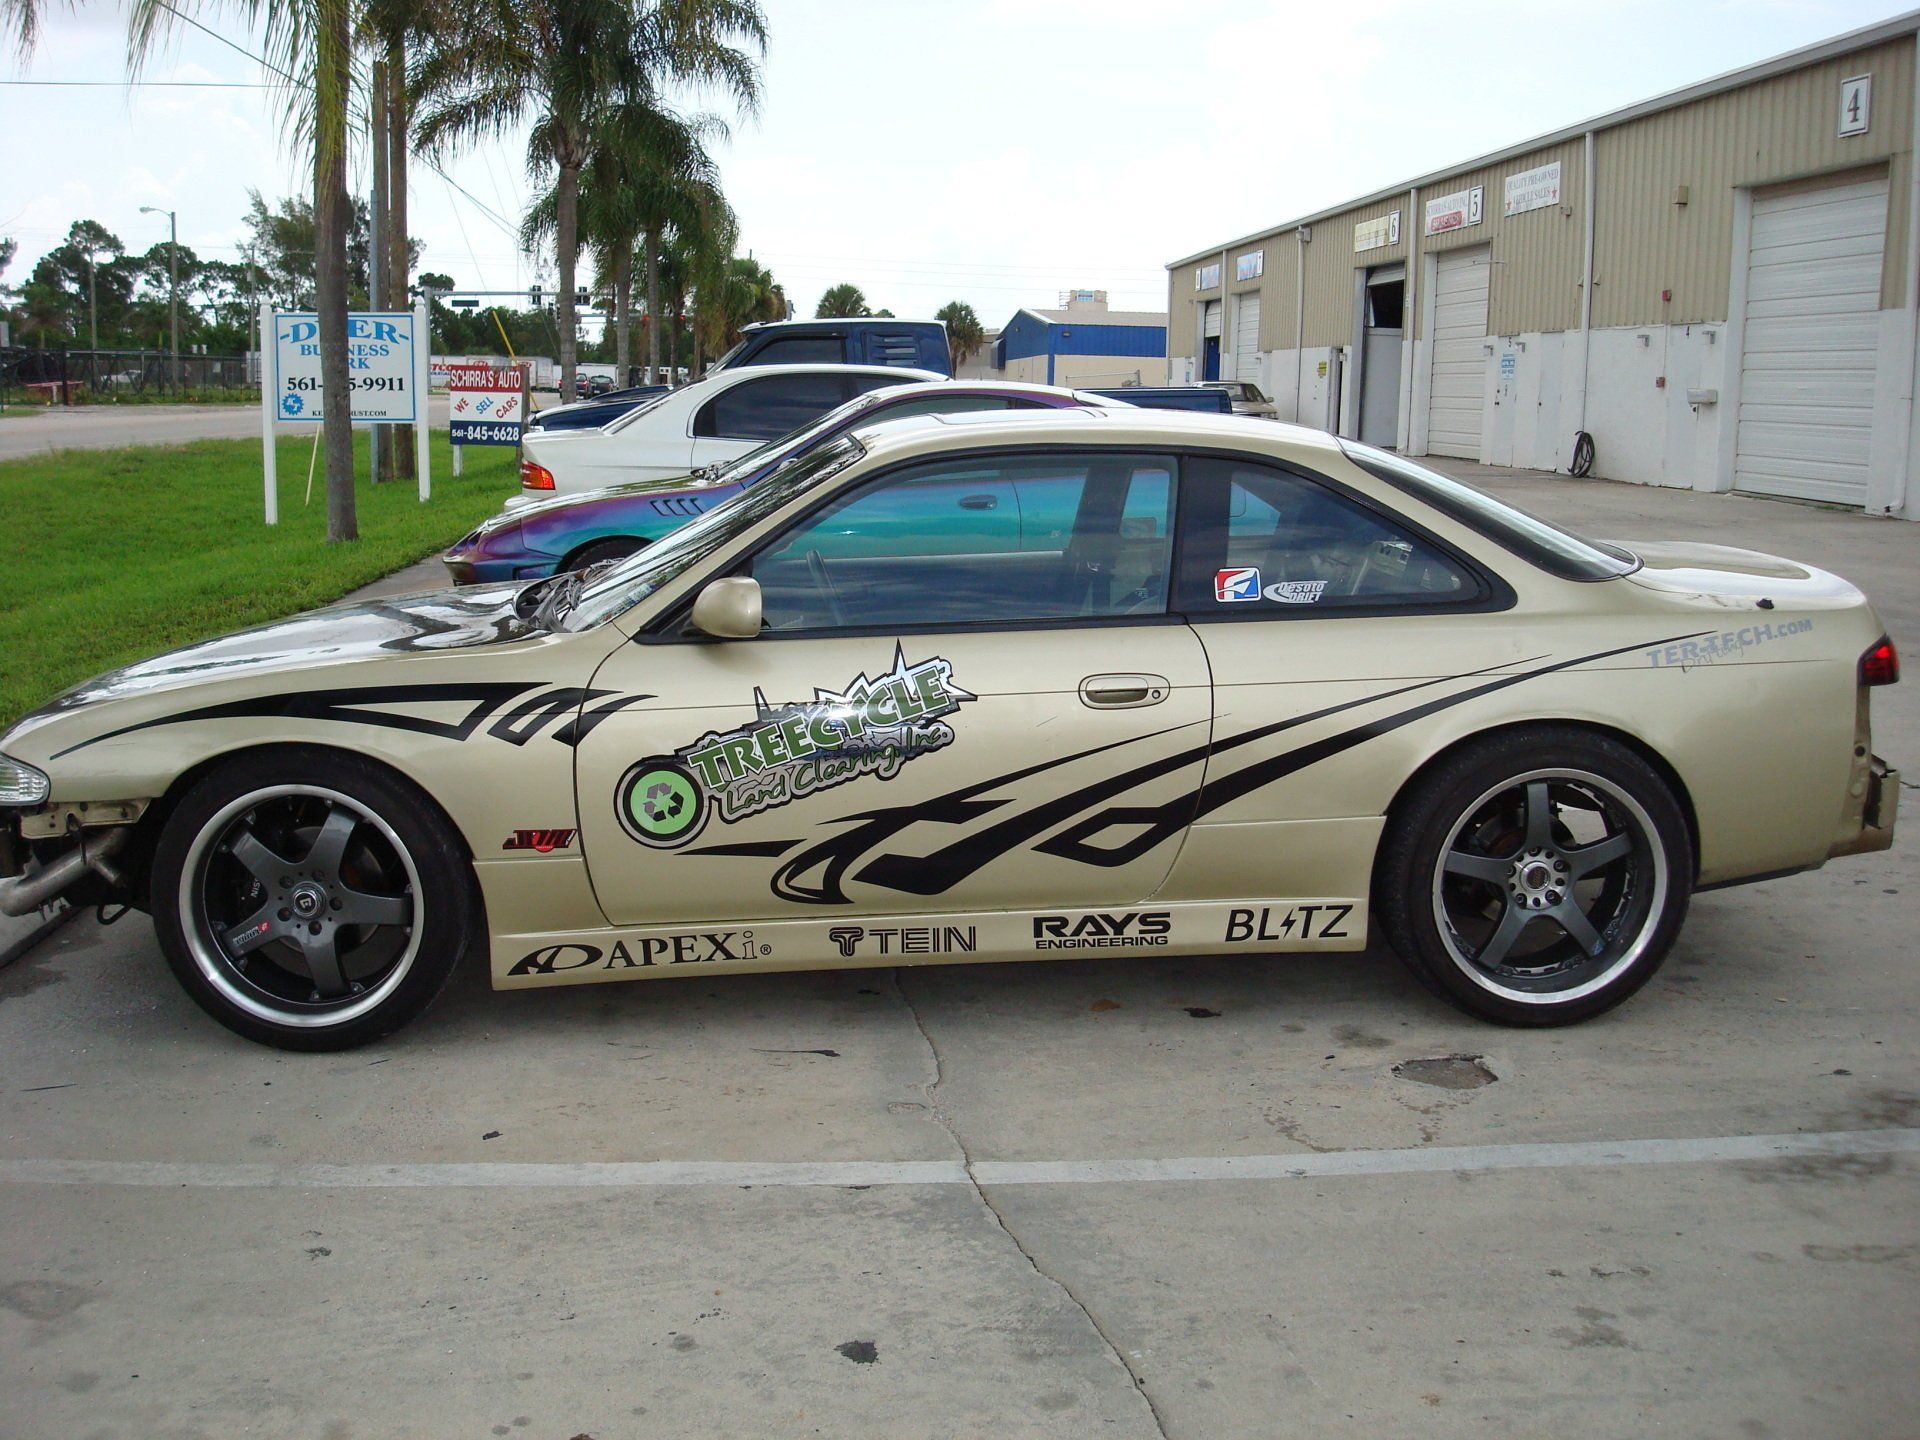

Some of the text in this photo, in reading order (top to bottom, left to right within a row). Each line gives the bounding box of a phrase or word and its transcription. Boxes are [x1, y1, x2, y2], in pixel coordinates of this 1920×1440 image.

[1847, 88, 1860, 123] 4
[1472, 194, 1478, 217] 5
[1391, 217, 1397, 238] 6
[290, 319, 400, 345] DER
[300, 344, 389, 357] BUNESS
[346, 358, 370, 369] RK
[287, 376, 405, 392] 561-5-9911
[451, 369, 520, 388] SCHIRRA'S AUTO
[454, 396, 518, 419] WE SELL CARS
[452, 426, 519, 441] 561-845-6628
[1289, 592, 1323, 602] DRIFT
[687, 668, 952, 789] TREECYCLE
[727, 776, 786, 815] Land
[1033, 911, 1171, 938] RAYS
[1225, 904, 1354, 942] BLITZ
[1035, 936, 1169, 950] ENGINEERING
